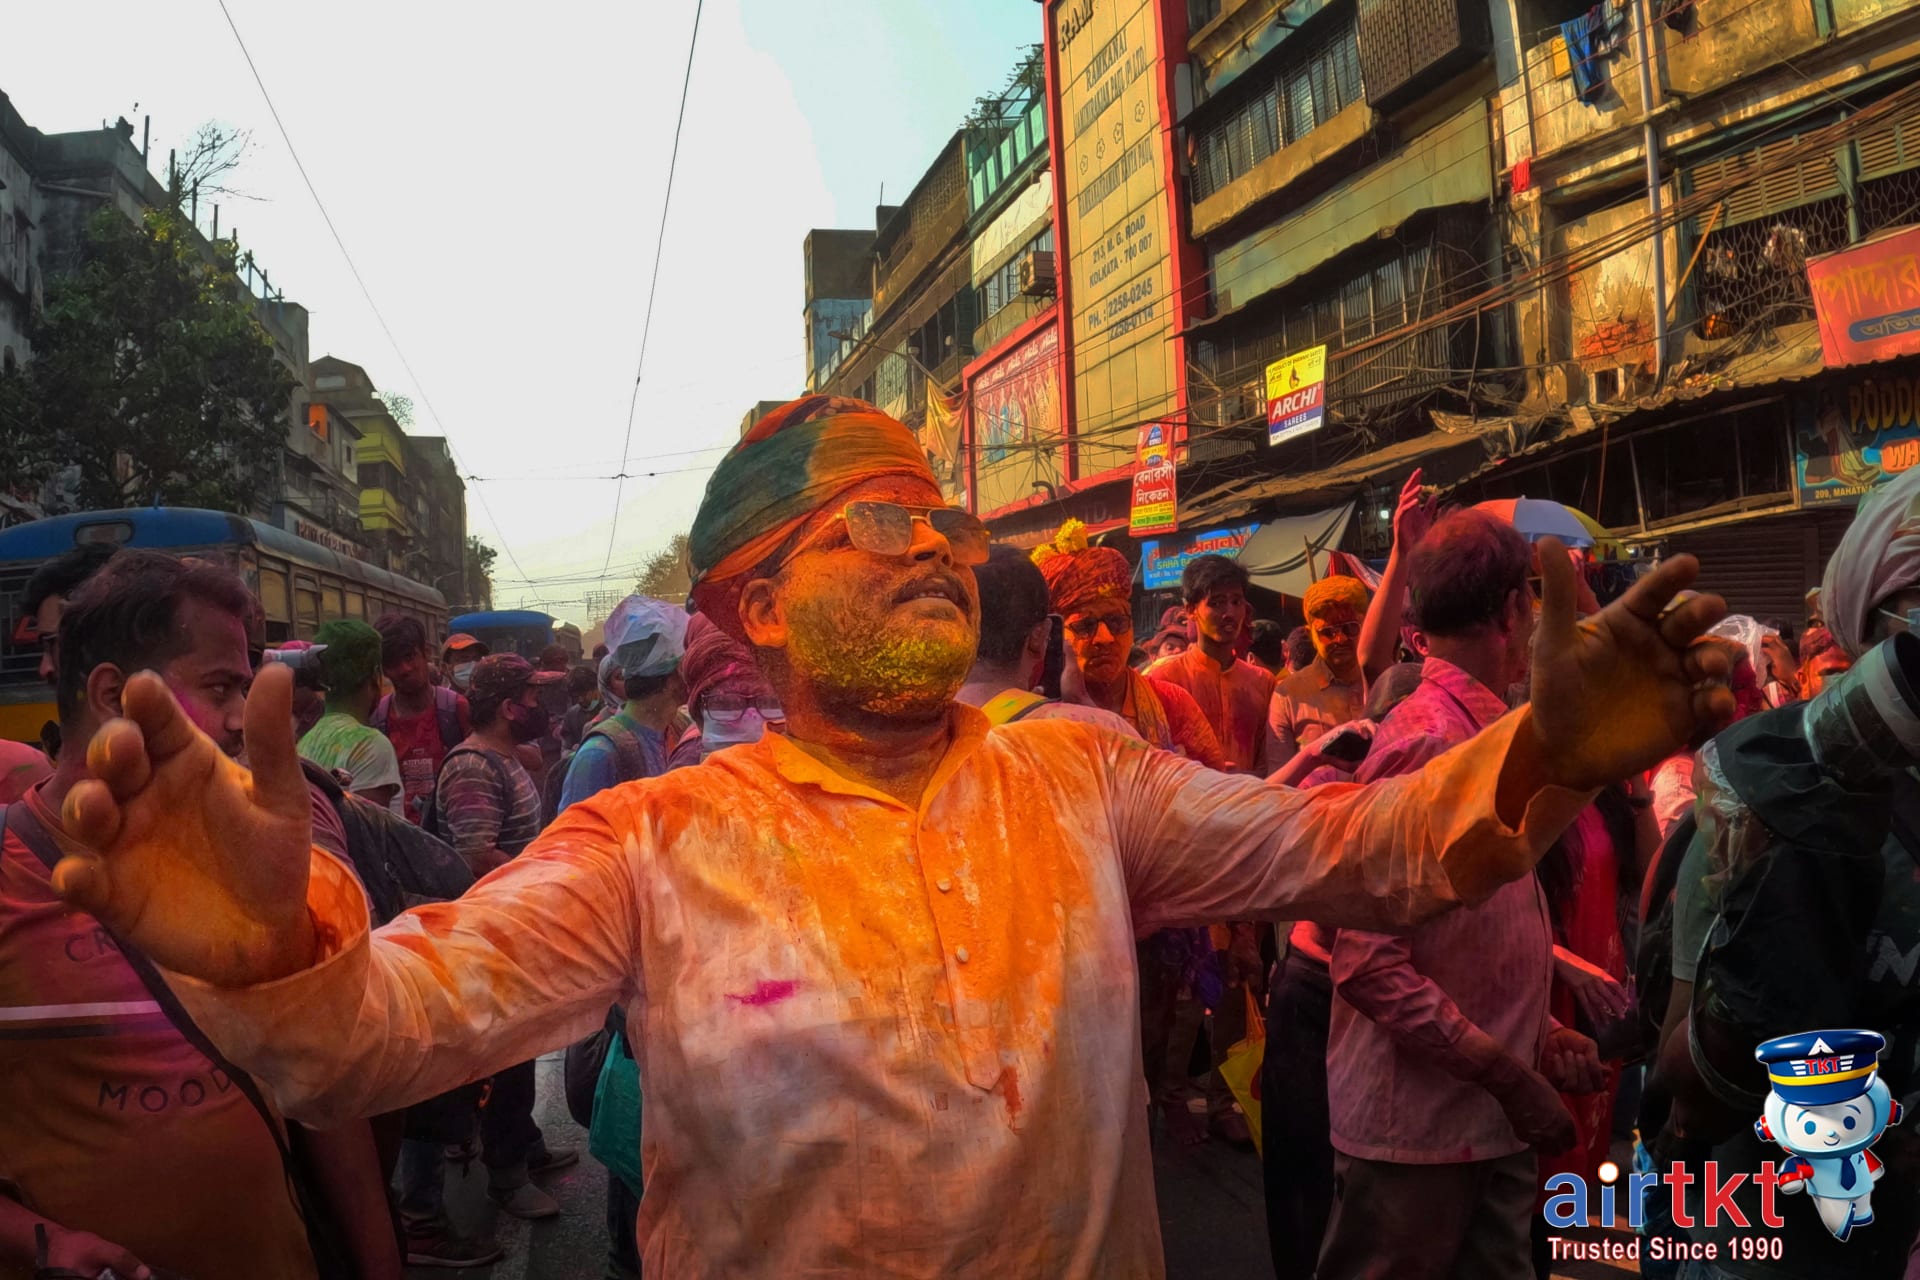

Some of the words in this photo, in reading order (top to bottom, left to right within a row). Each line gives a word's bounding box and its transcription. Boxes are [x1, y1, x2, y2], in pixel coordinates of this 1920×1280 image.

[1125, 215, 1146, 240] ROAD
[1089, 256, 1119, 288] KOLKATA
[1123, 243, 1137, 264] 700
[1138, 232, 1153, 253] 007
[1271, 386, 1317, 420] ARCHI
[1284, 413, 1307, 428] SAREES
[1136, 489, 1169, 505] নিকেতন
